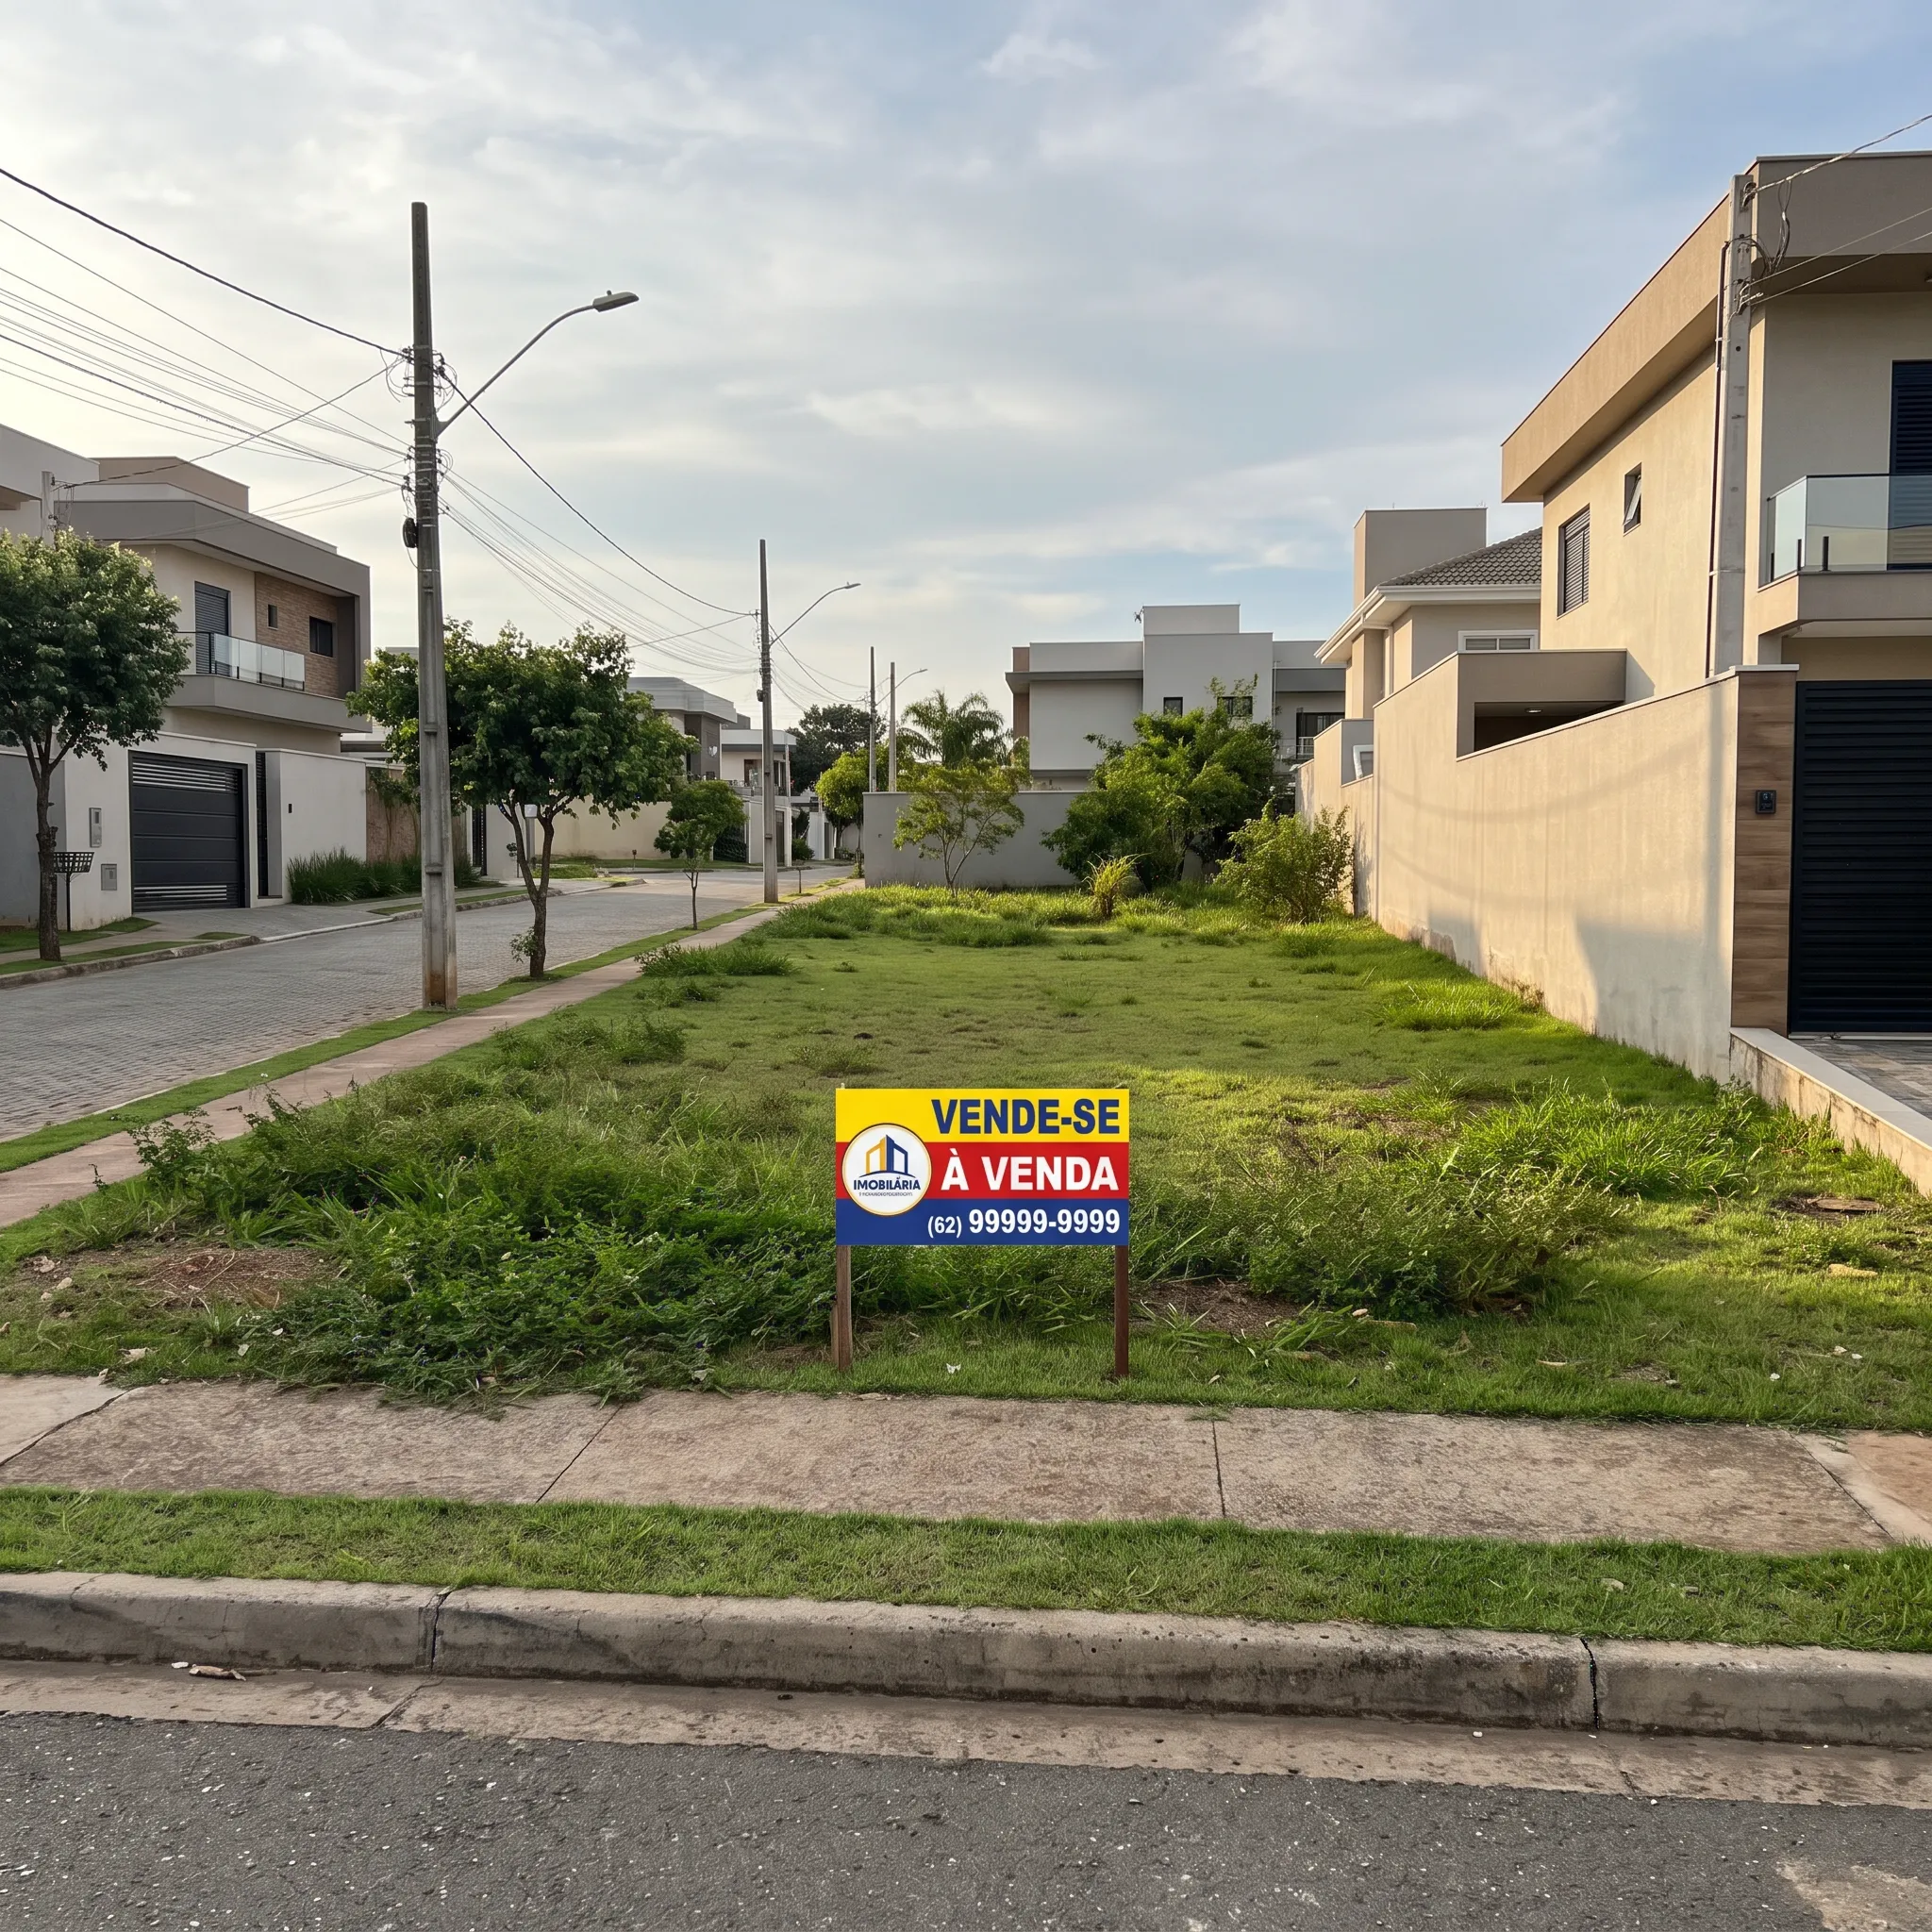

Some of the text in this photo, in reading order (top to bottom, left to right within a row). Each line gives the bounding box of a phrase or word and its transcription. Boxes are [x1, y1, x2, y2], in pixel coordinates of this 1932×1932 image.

[931, 1098, 1120, 1135] VENDE-SE
[941, 1148, 1119, 1191] À VENDA
[927, 1208, 1120, 1238] (62) 99999-9999
